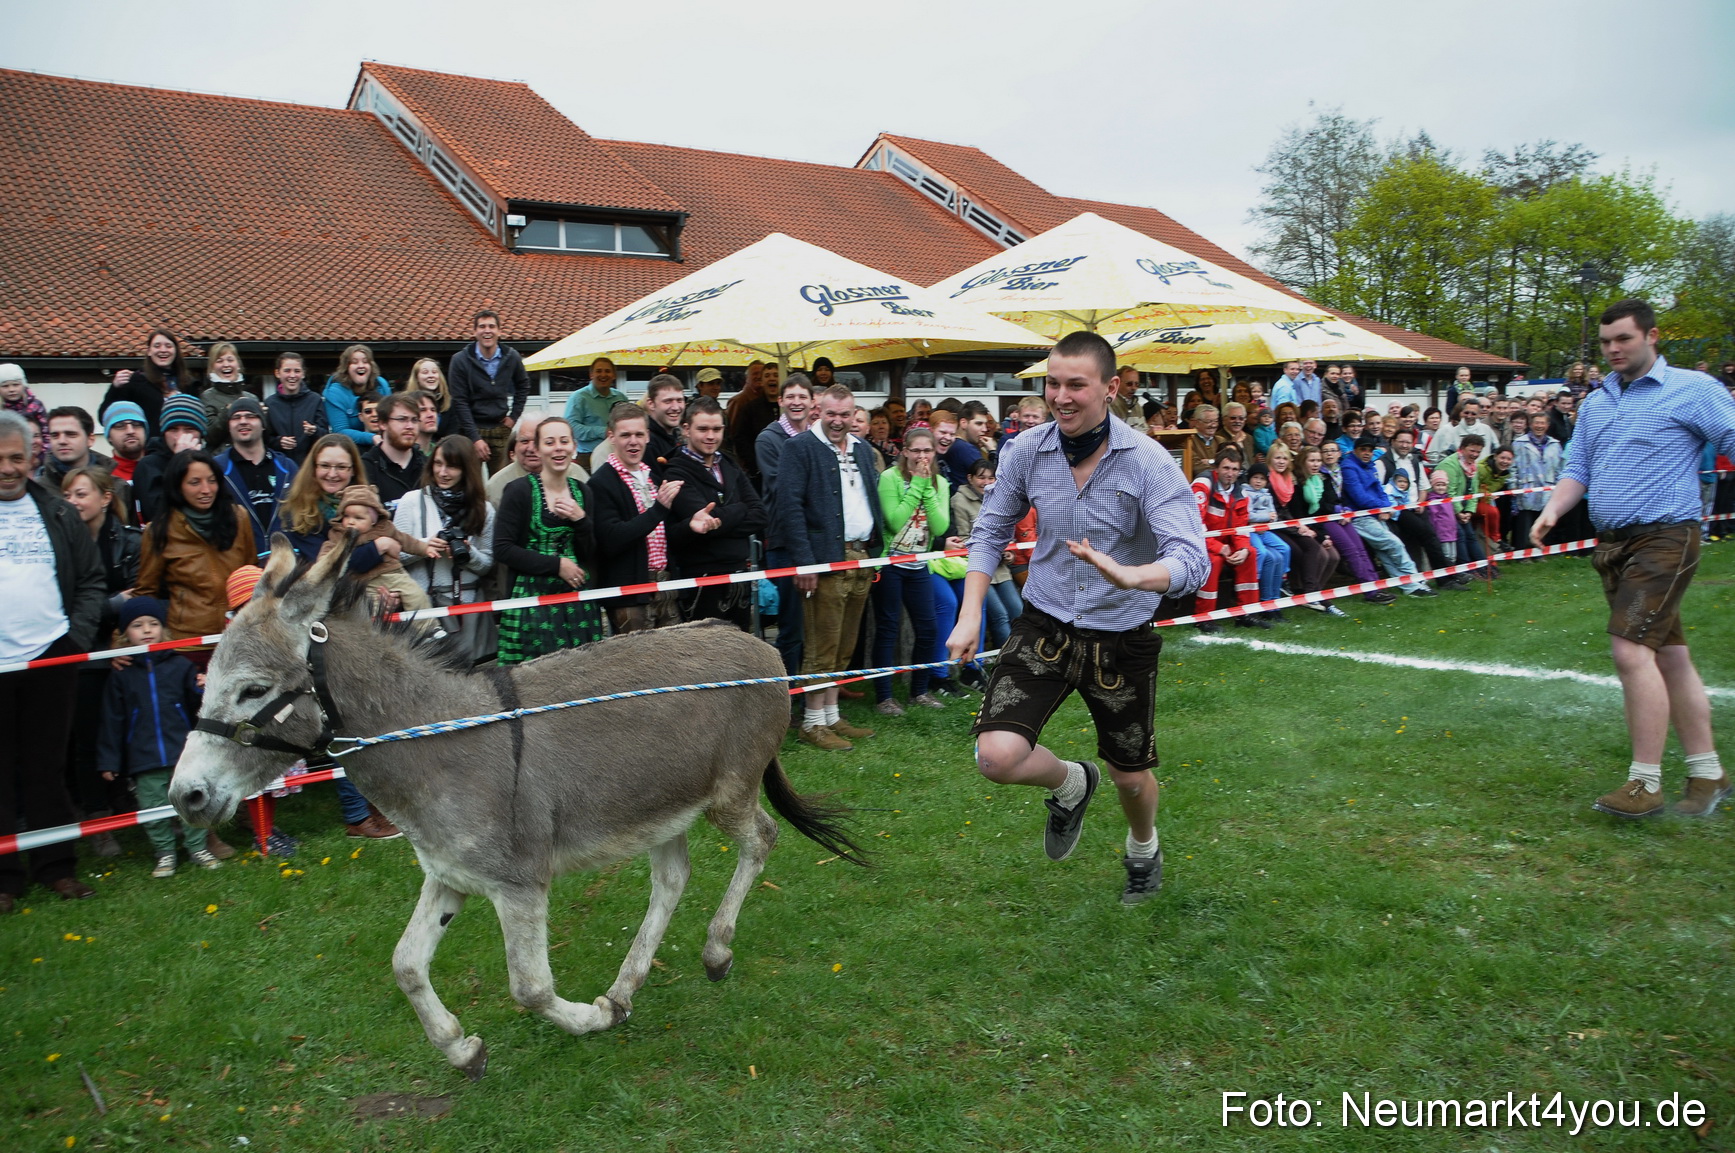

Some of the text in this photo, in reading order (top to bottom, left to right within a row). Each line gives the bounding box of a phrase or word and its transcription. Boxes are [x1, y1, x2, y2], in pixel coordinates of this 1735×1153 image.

[998, 276, 1059, 290] Bier
[799, 284, 909, 316] Glossner
[880, 301, 936, 318] Bier
[1152, 331, 1206, 345] Bier
